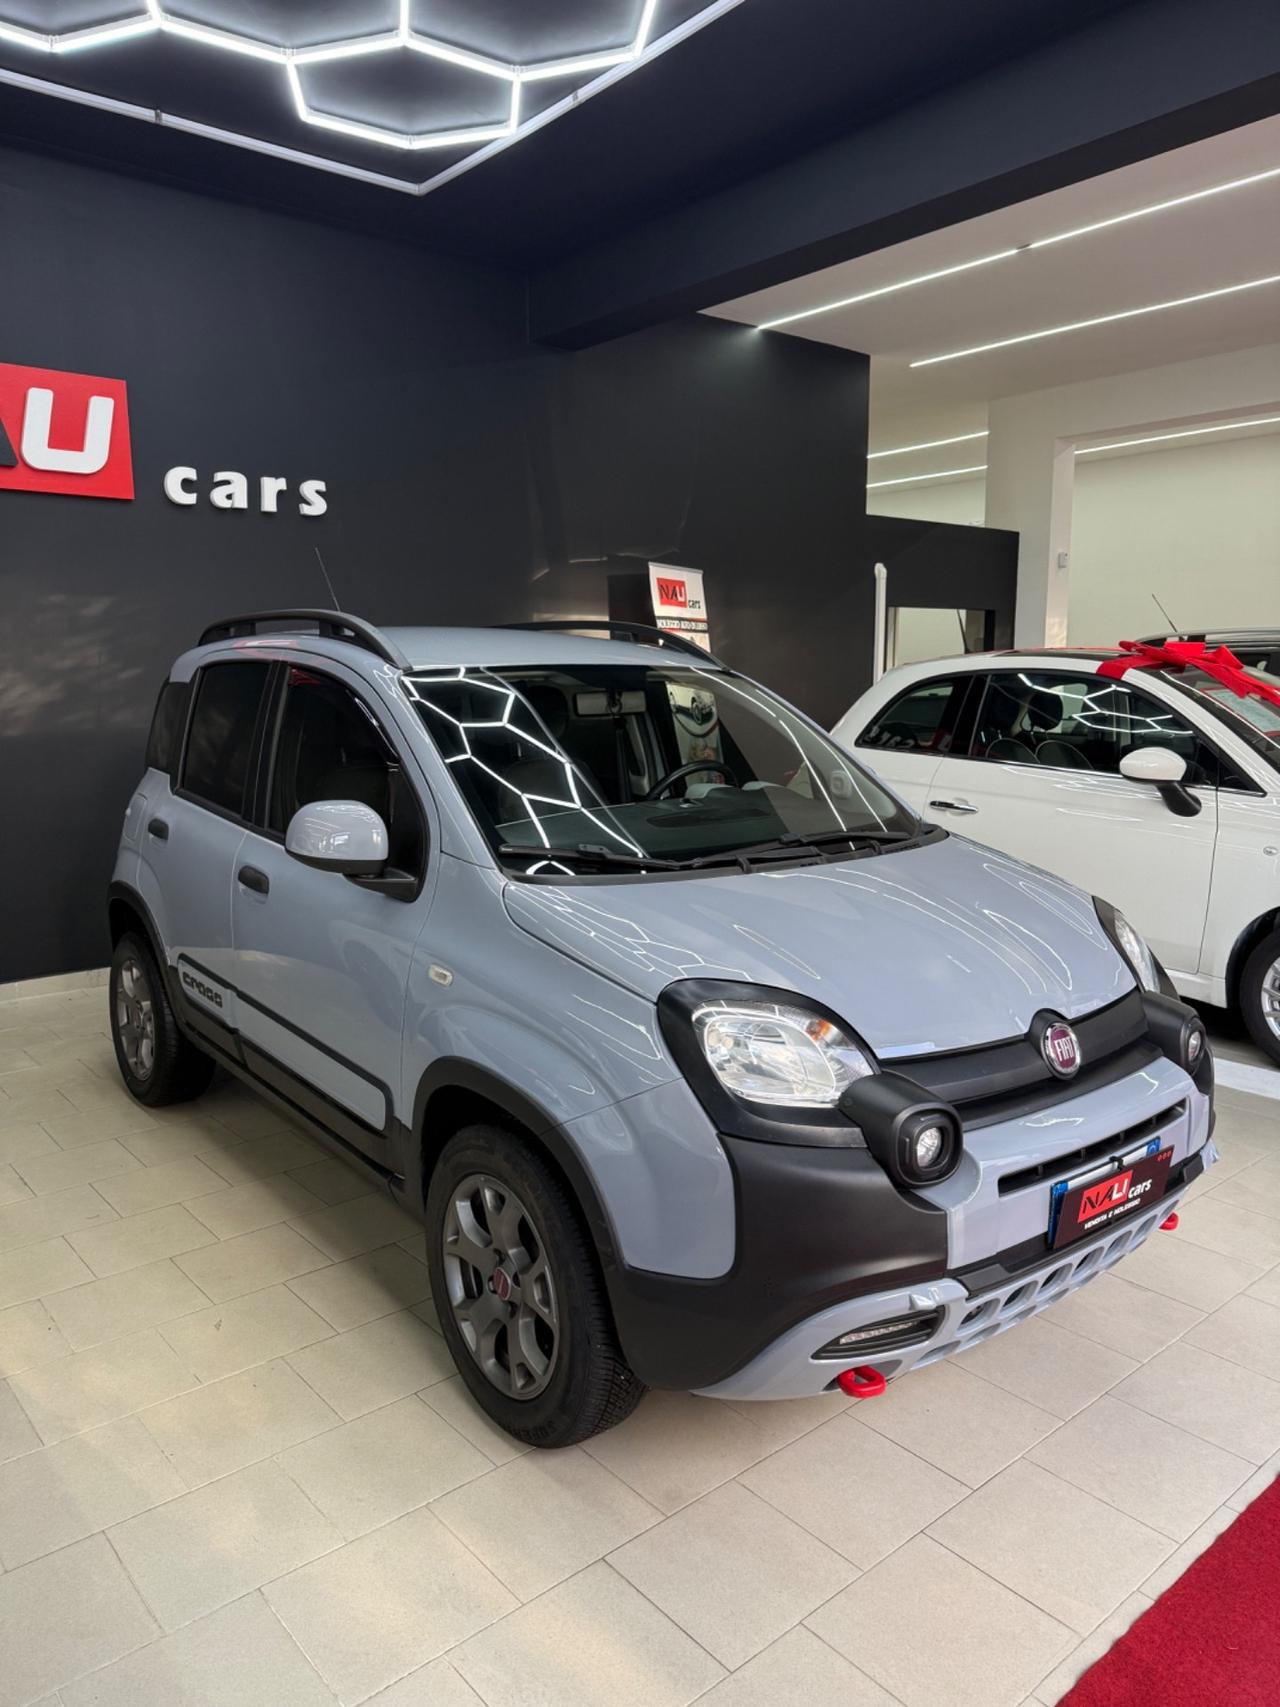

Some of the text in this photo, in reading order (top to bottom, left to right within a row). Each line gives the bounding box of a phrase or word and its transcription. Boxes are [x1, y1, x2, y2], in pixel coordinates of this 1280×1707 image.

[164, 466, 327, 516] cars
[1054, 1036, 1075, 1061] FIAT
[1128, 1179, 1152, 1199] cars
